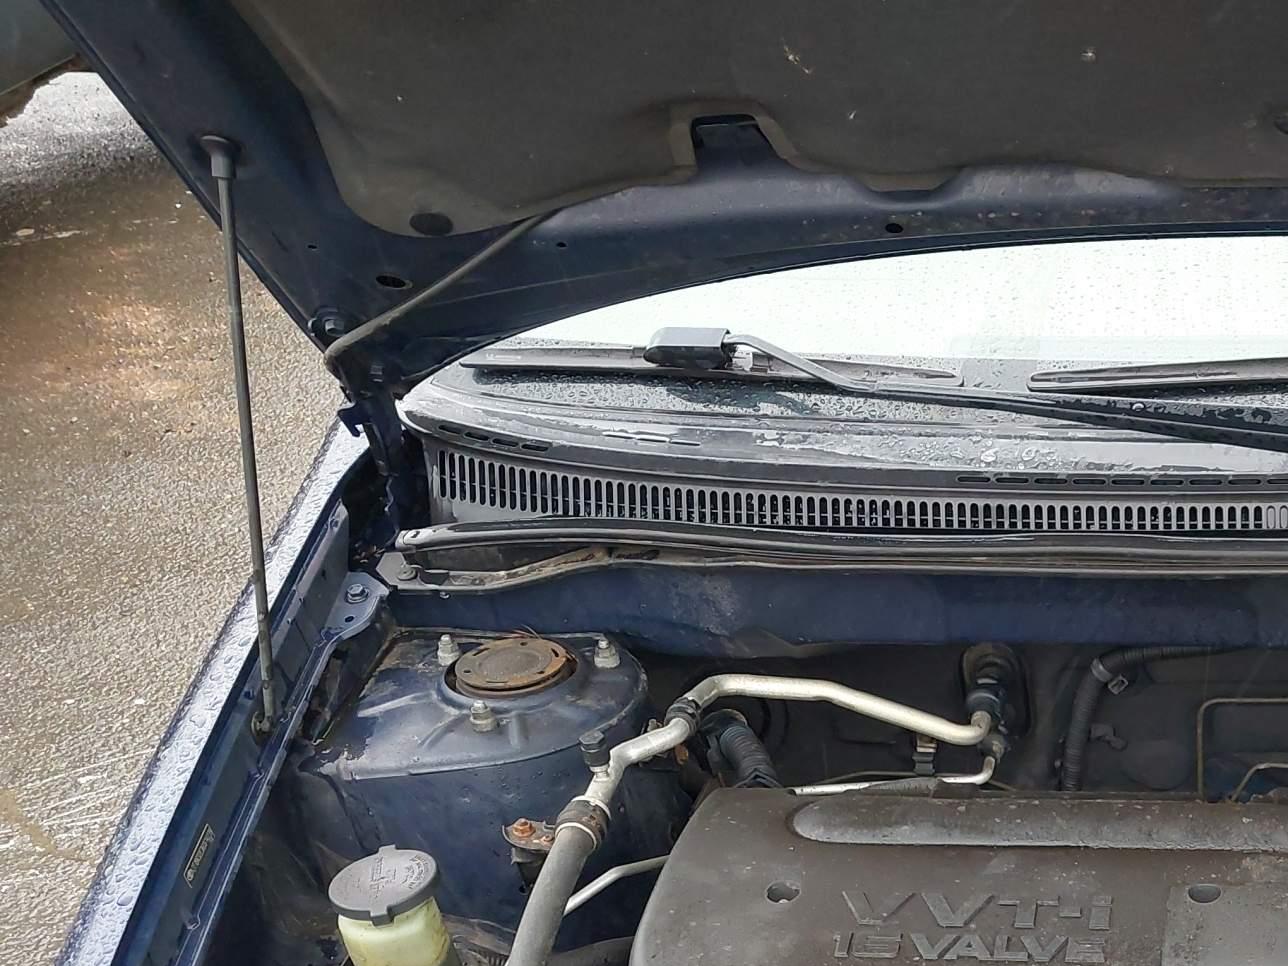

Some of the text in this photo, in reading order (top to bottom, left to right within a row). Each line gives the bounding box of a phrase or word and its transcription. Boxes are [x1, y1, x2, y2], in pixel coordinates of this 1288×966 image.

[841, 890, 1113, 931] VVT-i
[832, 932, 1106, 964] 16 VALVE
